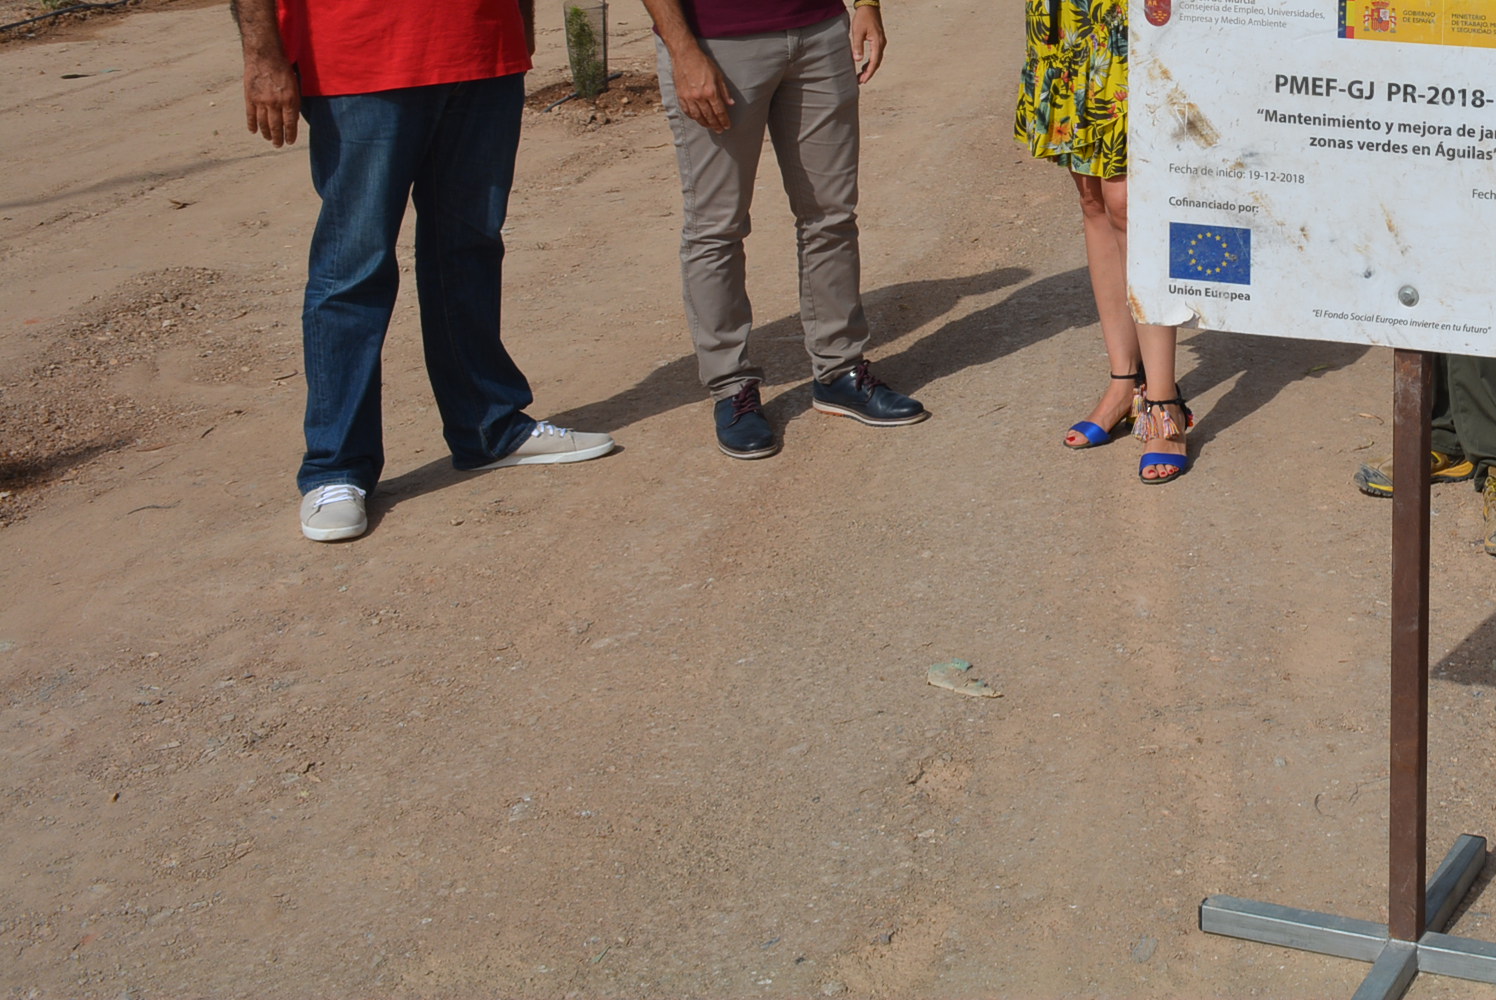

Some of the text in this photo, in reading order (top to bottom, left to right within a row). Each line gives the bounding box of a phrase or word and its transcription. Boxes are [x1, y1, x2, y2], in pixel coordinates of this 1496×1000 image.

[1179, 2, 1326, 20] Consejería de Empleo, Universidades,
[1402, 9, 1436, 18] GOBIERNO
[1451, 13, 1487, 21] MINISTERIO
[1179, 13, 1288, 29] Empresa y Medio Ambiente
[1402, 16, 1436, 25] DE ESPAÑA
[1457, 26, 1493, 35] SEGURIDAD
[1274, 73, 1376, 101] PMEF-GJ
[1256, 108, 1381, 131] “Mantenimiento
[1385, 121, 1395, 135] y
[1398, 121, 1452, 138] mejora
[1456, 123, 1476, 139] de
[1309, 136, 1354, 150] zonas
[1357, 137, 1409, 155] verdes
[1412, 143, 1431, 157] en
[1169, 163, 1305, 184] Fecha de inicio: 19-12-2018
[1168, 196, 1259, 214] Cofinanciado por:
[1168, 284, 1251, 302] Unión Europea
[1323, 310, 1349, 320] Fondo
[1349, 312, 1375, 323] Social
[1375, 315, 1409, 328] Europeo
[1409, 318, 1439, 330] invierte
[1440, 323, 1451, 331] en
[1452, 323, 1462, 332] tu
